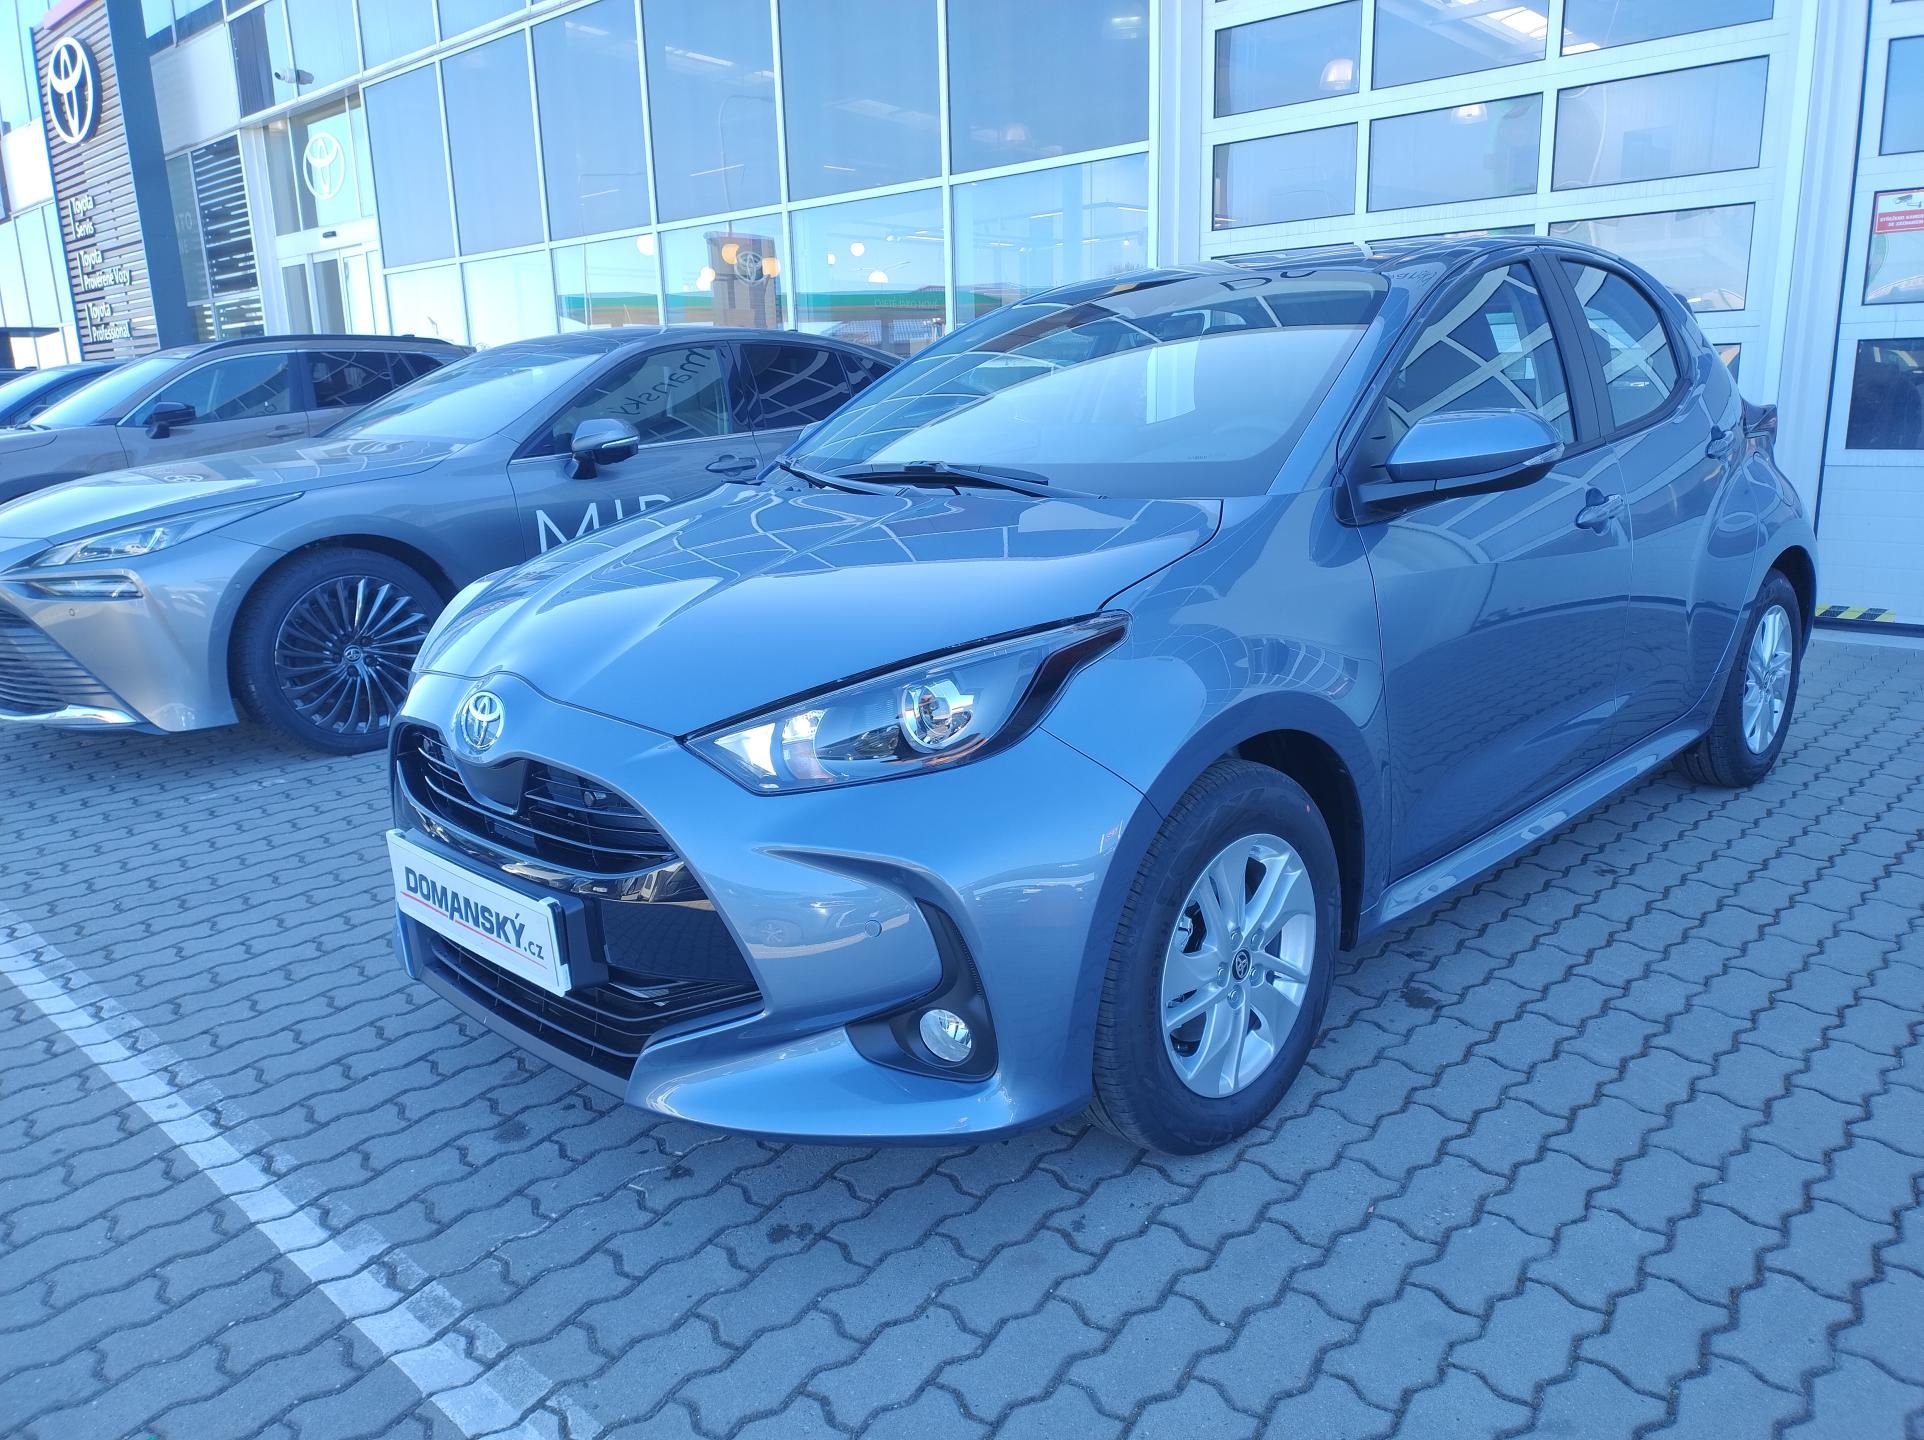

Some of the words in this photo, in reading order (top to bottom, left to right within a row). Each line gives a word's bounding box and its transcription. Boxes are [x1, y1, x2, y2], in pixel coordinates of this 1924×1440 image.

[71, 193, 94, 217] Toyota
[75, 218, 94, 238] Servis
[81, 249, 103, 272] Toyota
[113, 267, 130, 286] Vozy
[88, 302, 112, 321] Toyota
[92, 321, 130, 342] Professional
